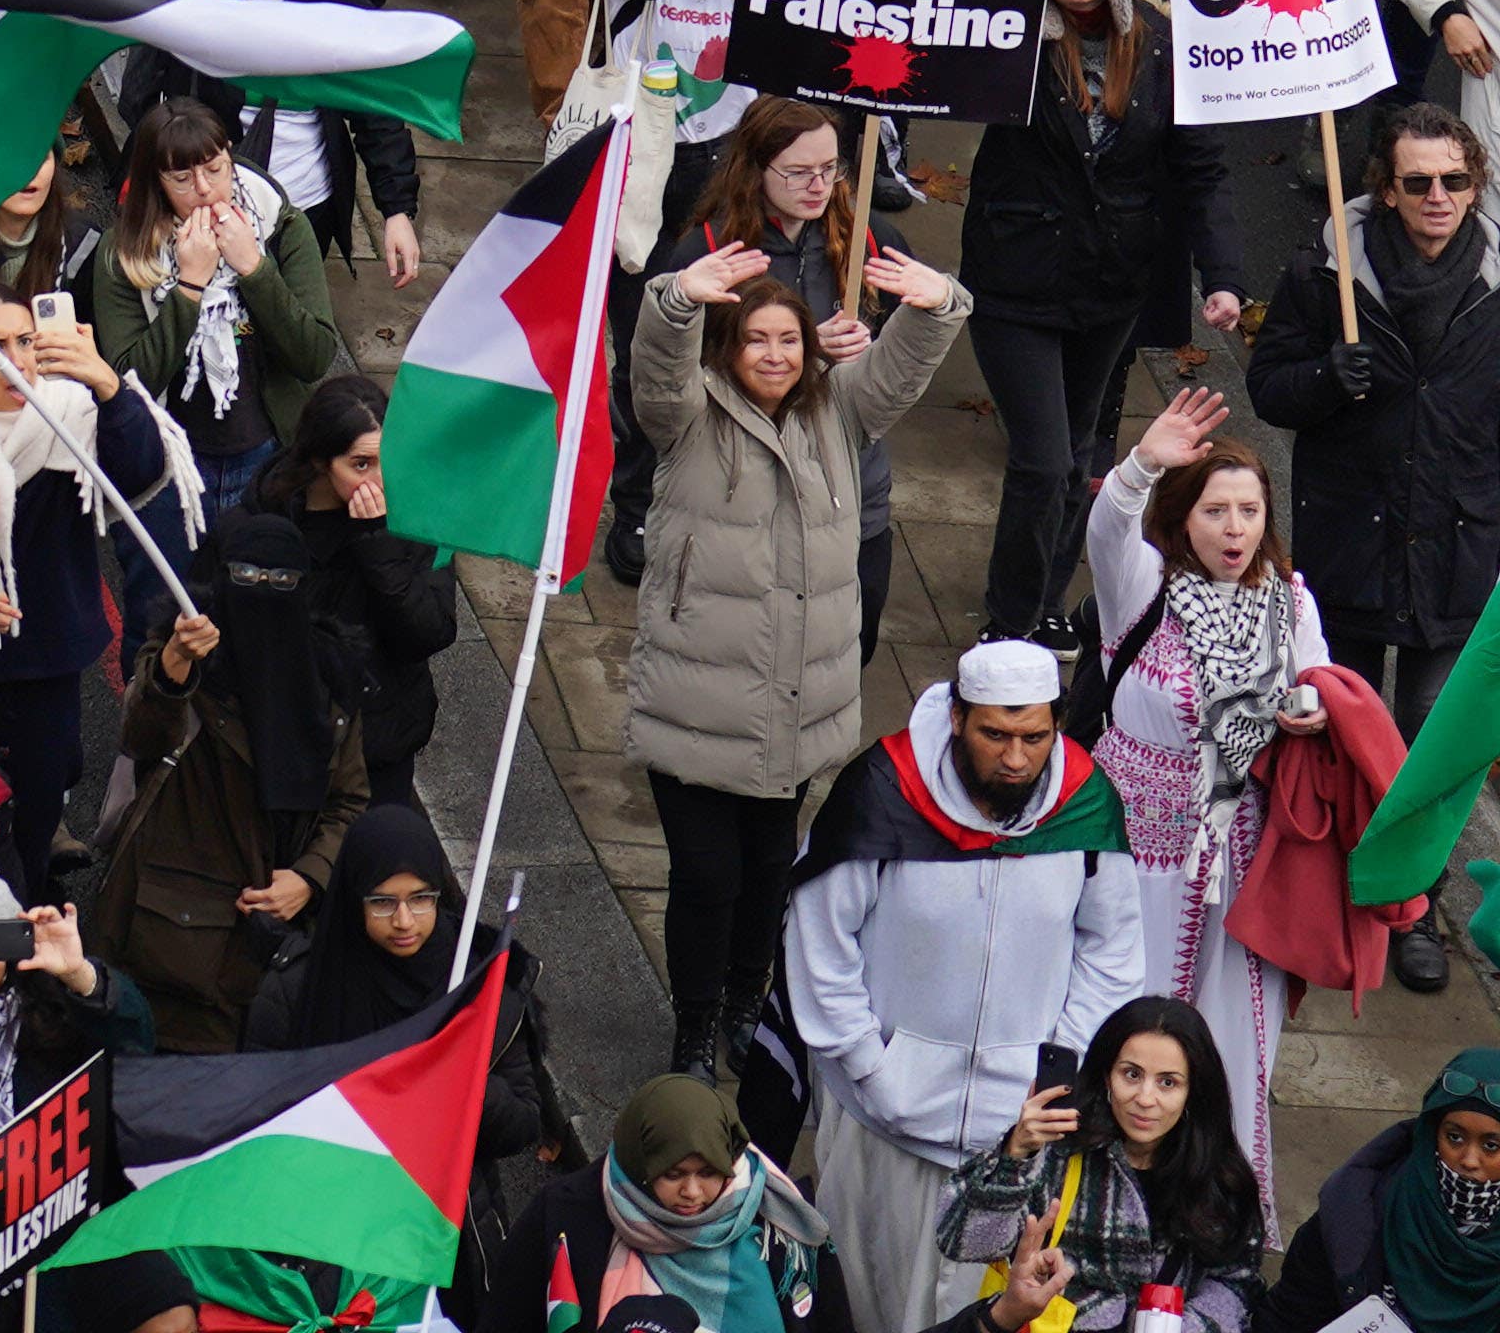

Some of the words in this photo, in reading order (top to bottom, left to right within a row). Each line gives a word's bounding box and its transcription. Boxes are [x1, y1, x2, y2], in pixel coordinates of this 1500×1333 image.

[1188, 42, 1243, 70] Stop
[1252, 36, 1297, 61] the
[1306, 16, 1371, 55] massacre
